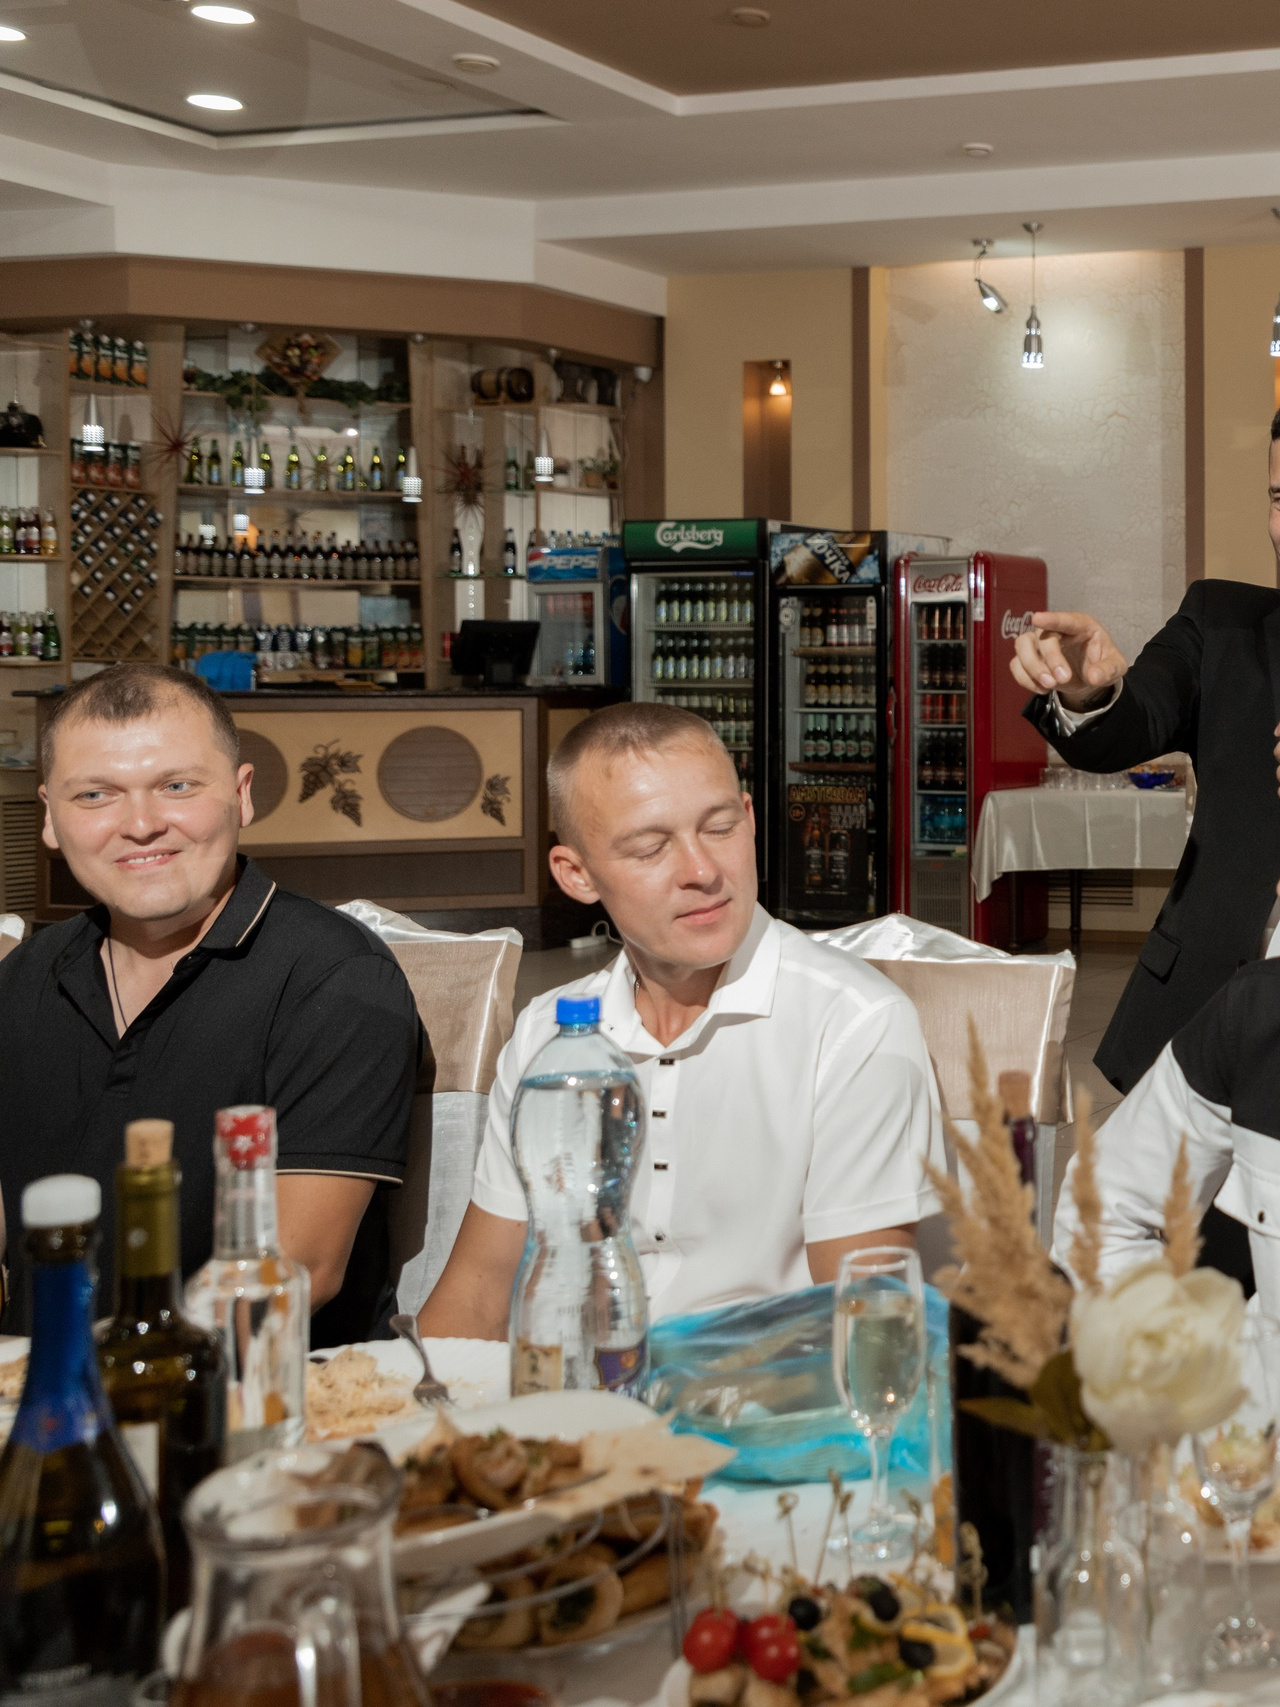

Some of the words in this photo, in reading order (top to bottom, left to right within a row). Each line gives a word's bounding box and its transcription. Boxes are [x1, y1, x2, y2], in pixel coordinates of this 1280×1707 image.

[655, 521, 724, 553] Carlsberg
[541, 553, 599, 570] PEPS
[789, 785, 867, 803] AMSTERDAM
